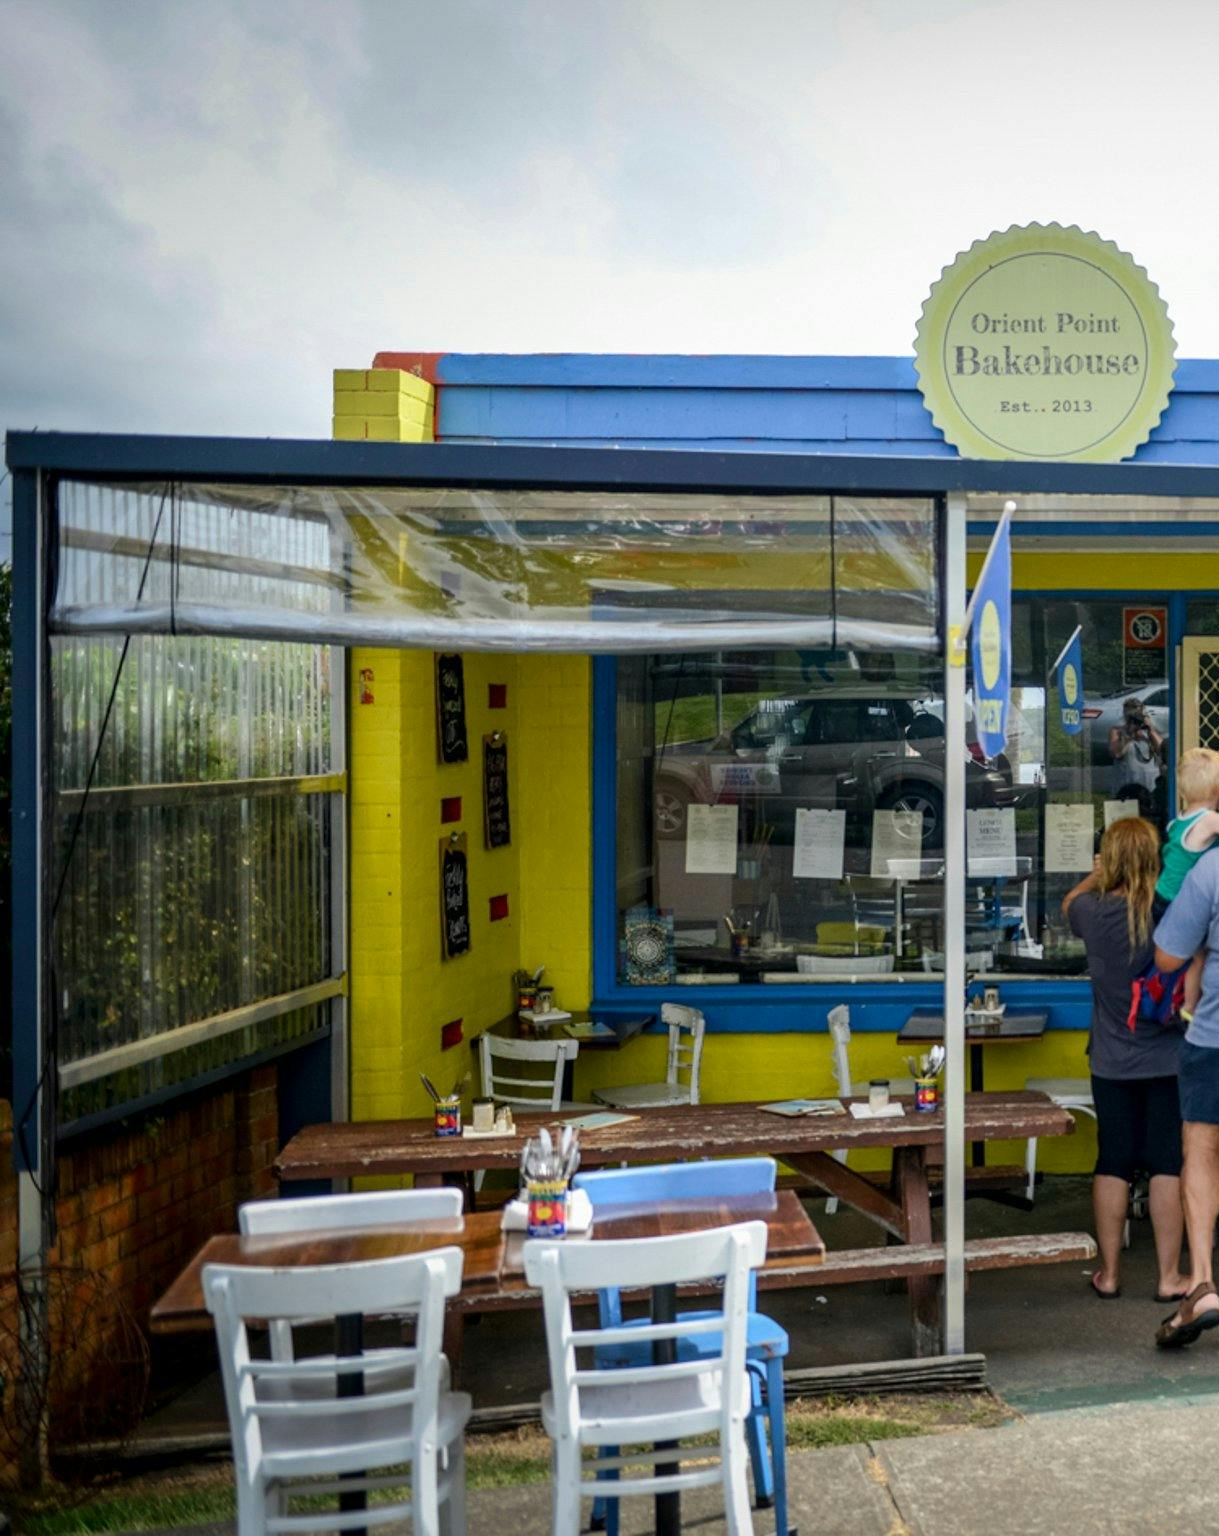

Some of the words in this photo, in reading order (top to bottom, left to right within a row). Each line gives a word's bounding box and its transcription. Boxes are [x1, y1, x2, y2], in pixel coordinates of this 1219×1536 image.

[971, 312, 1047, 334] Orient
[1056, 312, 1120, 334] Point
[954, 346, 1139, 376] Bakehouse
[1052, 400, 1092, 413] 2013
